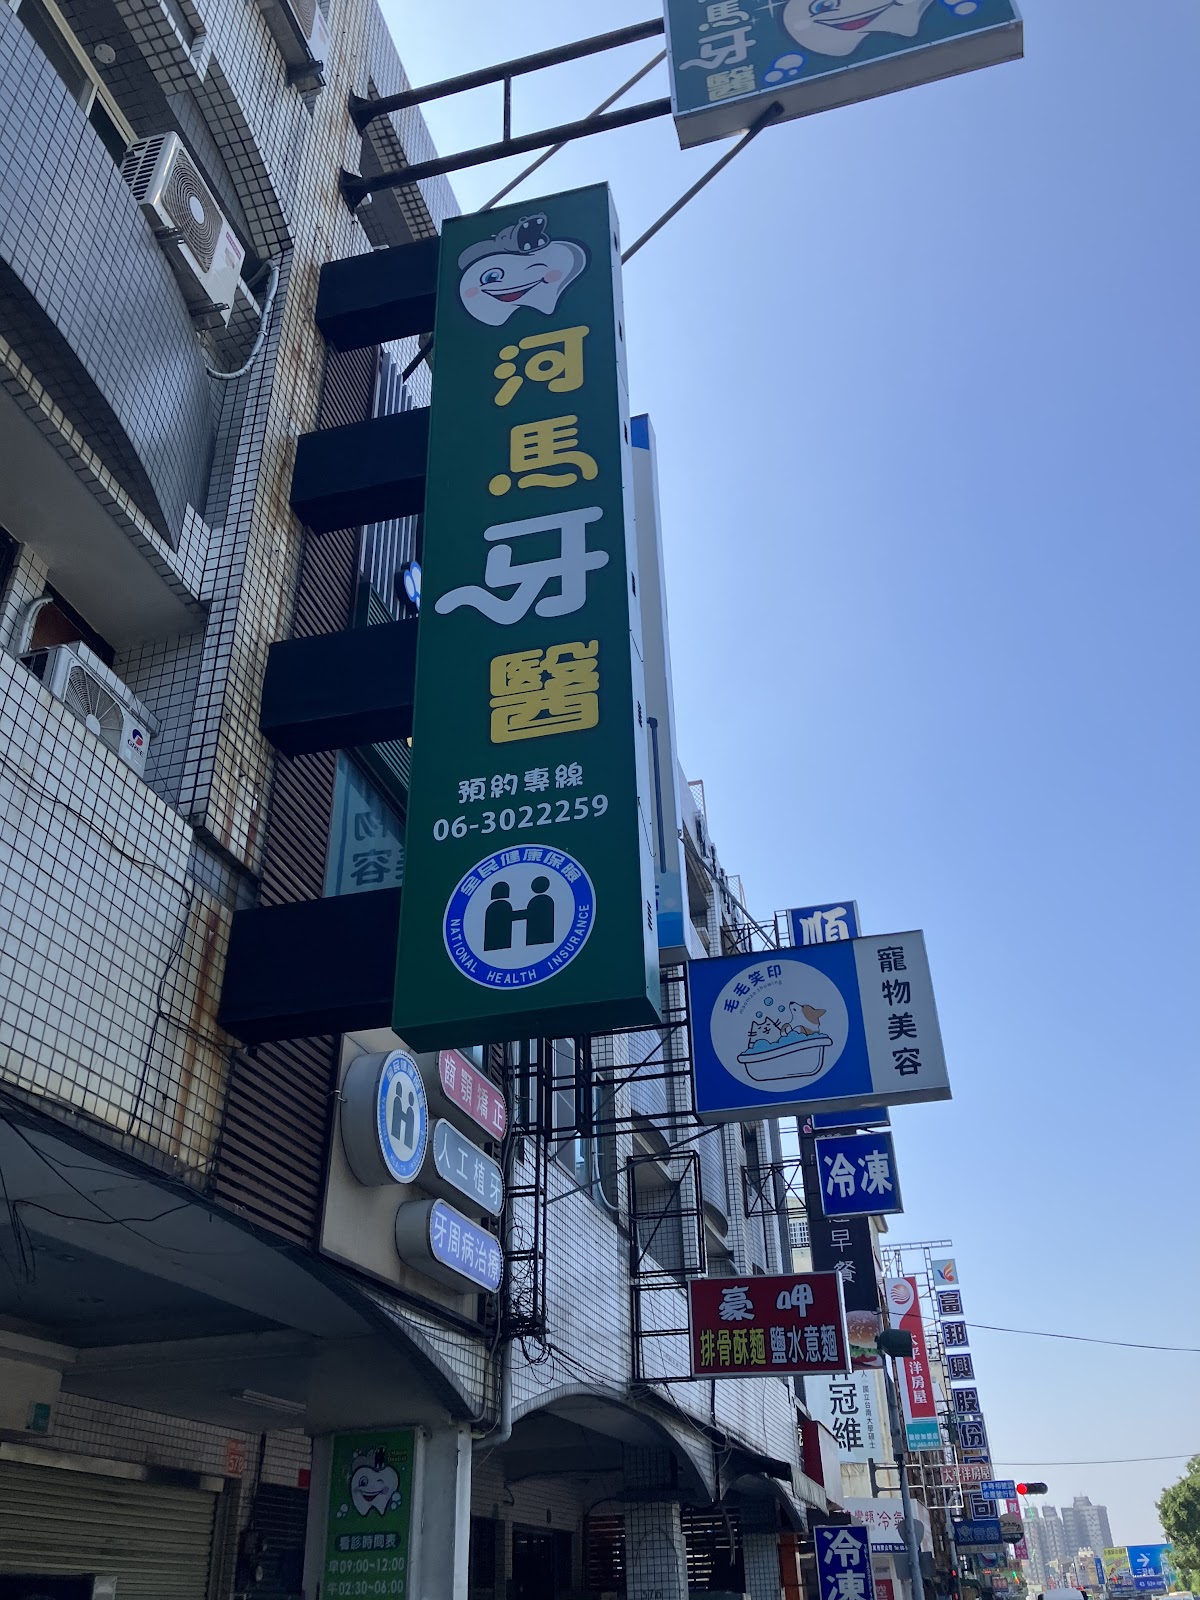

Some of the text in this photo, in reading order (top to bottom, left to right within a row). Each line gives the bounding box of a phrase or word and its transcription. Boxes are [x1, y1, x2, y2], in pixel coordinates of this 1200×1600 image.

[679, 0, 756, 101] 馬牙醫
[434, 325, 610, 743] 河馬牙醫
[458, 762, 583, 803] 預約專線
[432, 794, 609, 841] 06-3022259
[460, 848, 582, 897] 全民健康保險
[450, 904, 590, 984] NATIONAL HEALTH INSURANCE
[799, 906, 851, 945] 順
[724, 964, 782, 1013] 毛毛笑印
[876, 945, 922, 1076] 寵物美容
[444, 1053, 504, 1132] 齒顎矯正
[438, 1132, 501, 1207] 人工植牙
[823, 1150, 893, 1198] 冷凍
[433, 1210, 500, 1283] 牙周病治療
[828, 1219, 857, 1283] 早餐
[718, 1283, 814, 1322] 豪呷
[700, 1328, 767, 1368] 排骨酥麵
[769, 1324, 839, 1365] 鹽水意麵
[829, 1374, 864, 1452] 冠維
[939, 1291, 997, 1517] 富邦興股份司
[943, 1465, 991, 1481] 太平洋房屋
[339, 1534, 396, 1550] 看診時間表
[822, 1529, 867, 1600] 冷凍
